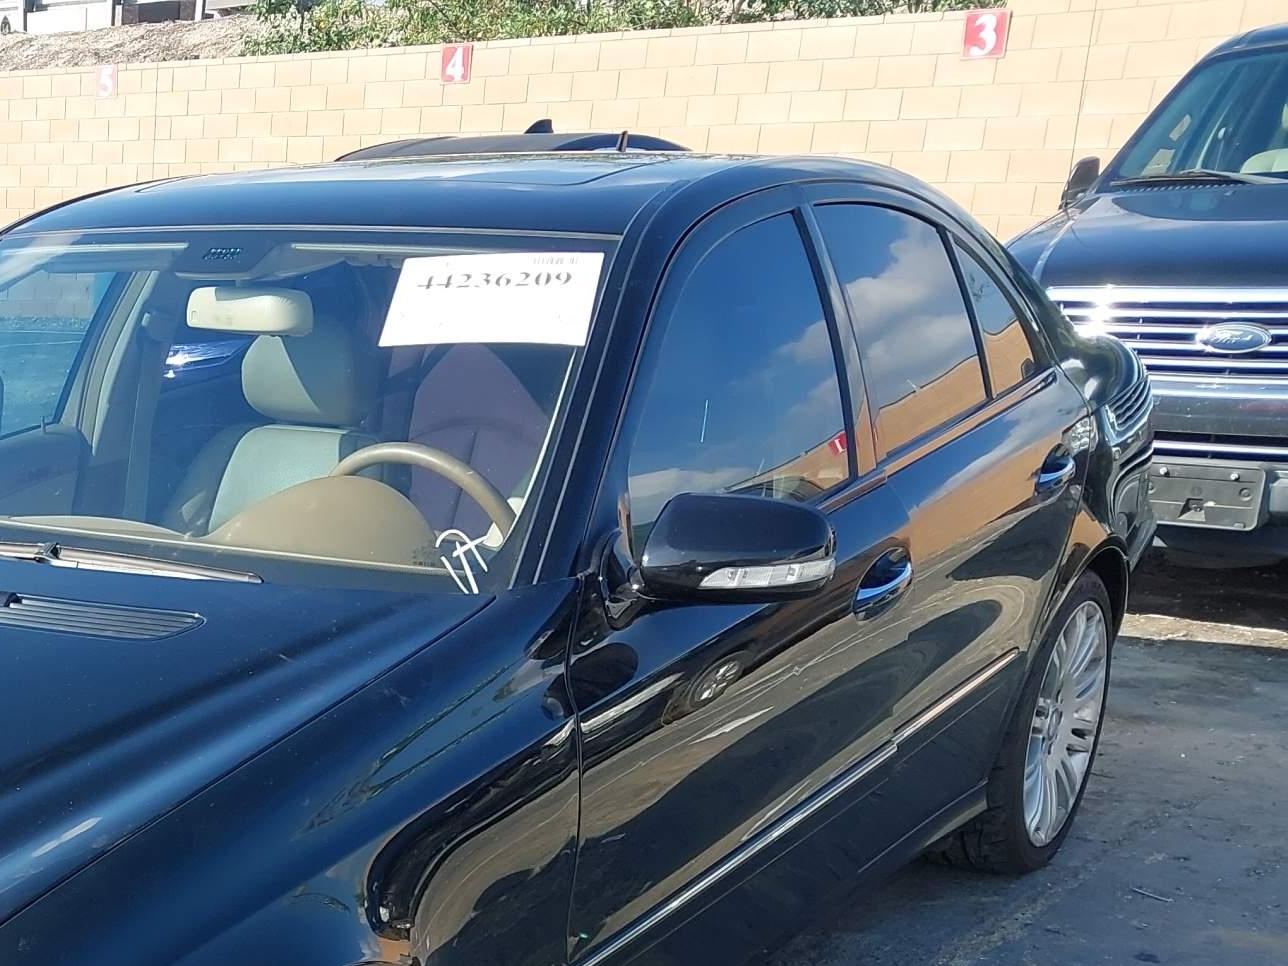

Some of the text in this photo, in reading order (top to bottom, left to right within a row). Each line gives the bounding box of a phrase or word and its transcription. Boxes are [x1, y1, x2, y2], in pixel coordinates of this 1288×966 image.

[968, 13, 997, 57] 3
[445, 46, 464, 81] 4
[417, 271, 573, 290] 44236209
